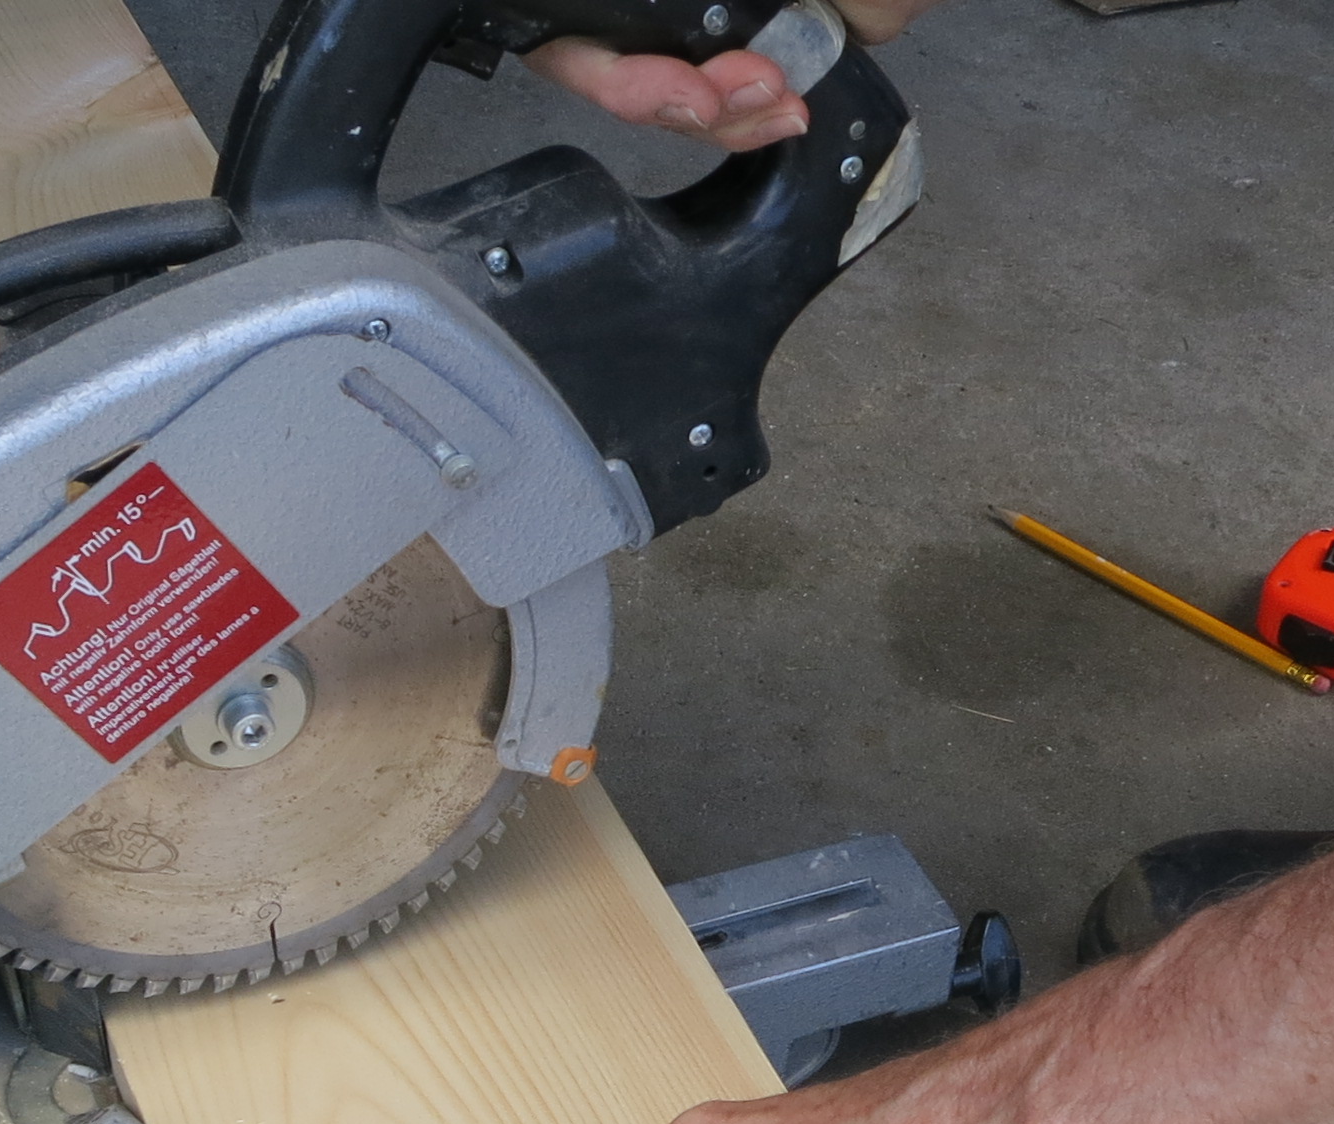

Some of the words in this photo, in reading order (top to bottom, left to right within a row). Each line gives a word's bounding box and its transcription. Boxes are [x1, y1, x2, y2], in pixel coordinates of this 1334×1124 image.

[79, 526, 121, 557] min.
[40, 628, 112, 686] Achtung!
[106, 613, 129, 633] Nur
[128, 578, 172, 616] Original
[50, 676, 70, 694] mit
[68, 644, 107, 680] negativ
[104, 606, 159, 649] Zahnform
[156, 555, 219, 608] verwenden!
[63, 647, 135, 708] Attention!
[134, 628, 162, 651] Only
[161, 612, 183, 631] use
[182, 567, 239, 614] sawblades
[73, 695, 99, 715] with
[97, 659, 142, 697] negative
[140, 637, 171, 661] tooth
[168, 612, 200, 639] form!
[174, 655, 197, 674] que
[196, 639, 219, 657] des
[216, 613, 251, 640] lames
[336, 616, 371, 639] PART
[87, 668, 158, 729] Attention!
[156, 634, 203, 673] N'utiliser
[105, 709, 147, 744] denture
[145, 670, 194, 711] negative!
